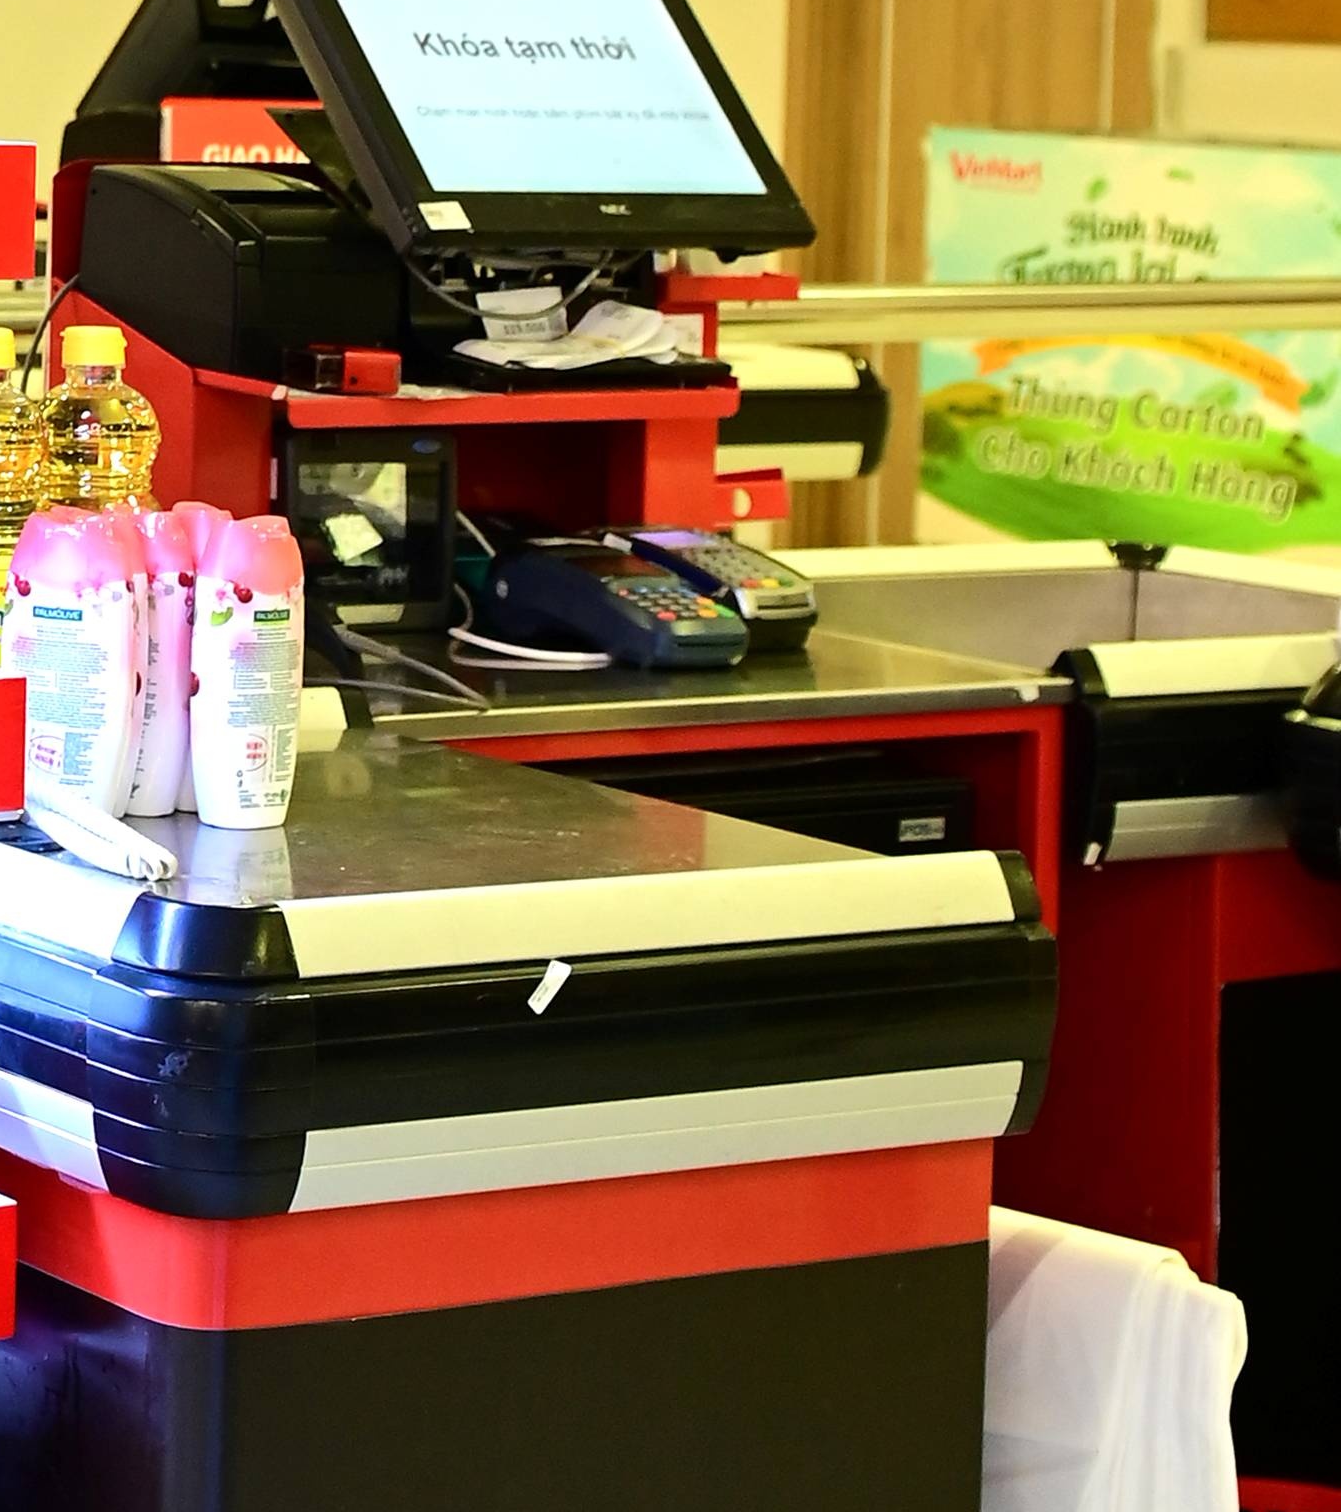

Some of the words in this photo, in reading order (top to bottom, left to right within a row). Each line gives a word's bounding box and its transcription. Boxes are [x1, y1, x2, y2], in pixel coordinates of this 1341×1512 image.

[412, 32, 500, 60] Khóa
[505, 35, 566, 65] tạm
[571, 35, 637, 61] thời
[1008, 374, 1118, 431] Thùng
[1131, 389, 1266, 441] Carton
[978, 431, 1050, 478] Cho
[1061, 441, 1179, 495] Khách
[1188, 460, 1297, 521] Hàng
